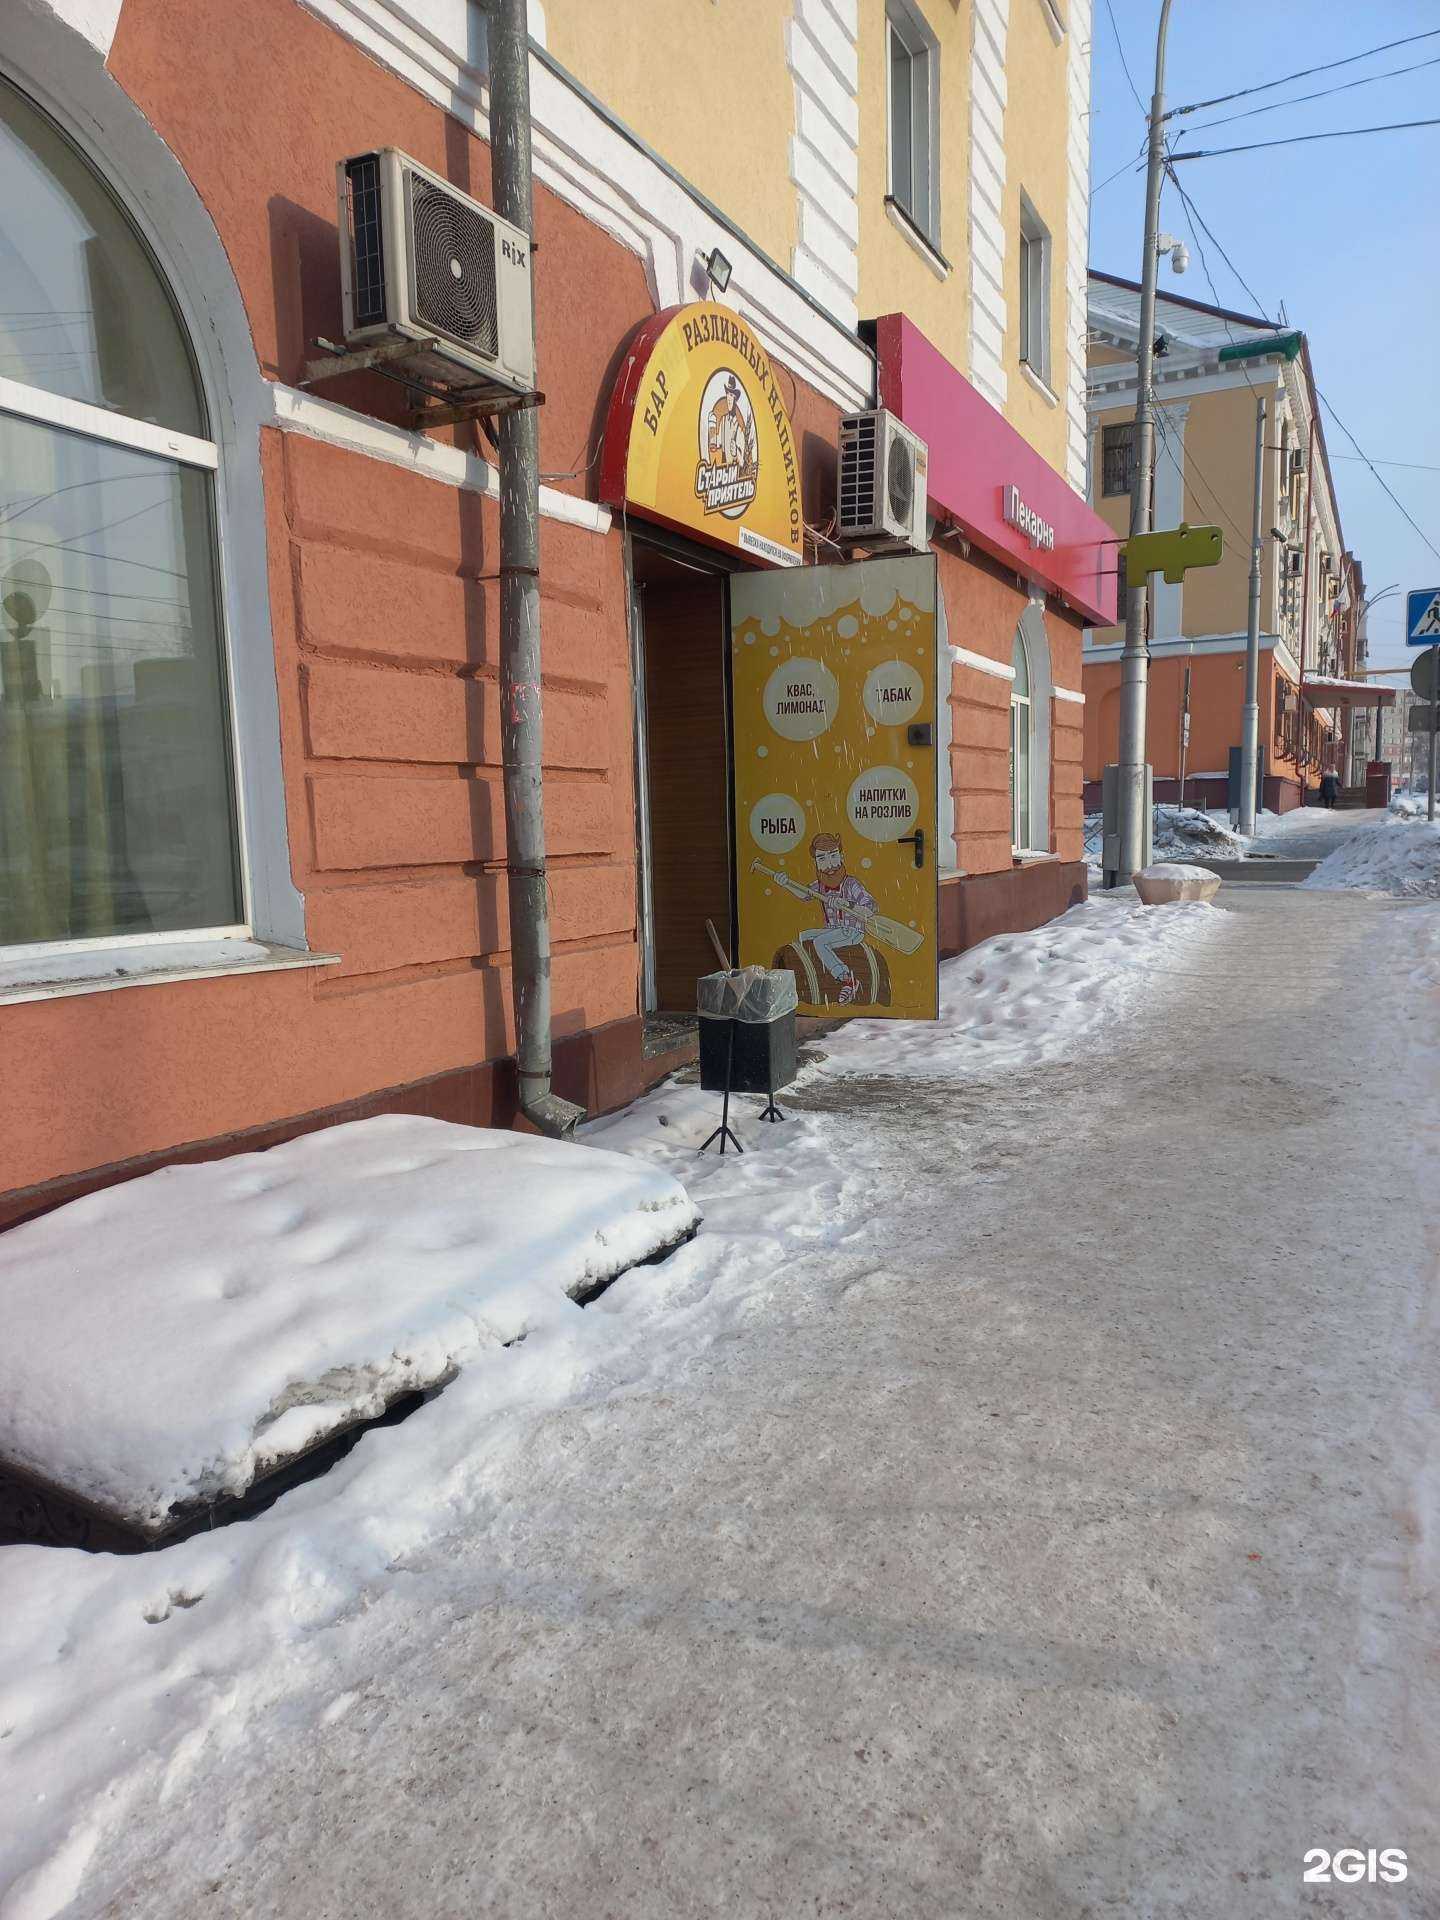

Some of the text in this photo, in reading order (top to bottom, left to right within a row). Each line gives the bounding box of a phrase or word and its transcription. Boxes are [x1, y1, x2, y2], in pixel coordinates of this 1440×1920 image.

[643, 313, 799, 544] БАР РАЗЛИВНЫХ НАПИТКОВ
[707, 479, 755, 508] ПРИЯТЕЛЬ
[1009, 484, 1055, 551] Пекарня
[786, 683, 815, 698] КВАС,
[775, 699, 826, 715] ЛИМОНАД
[859, 788, 907, 802] НАПИТКИ
[855, 804, 913, 819] НА РОЗЛИВ
[760, 817, 797, 835] РЫБА
